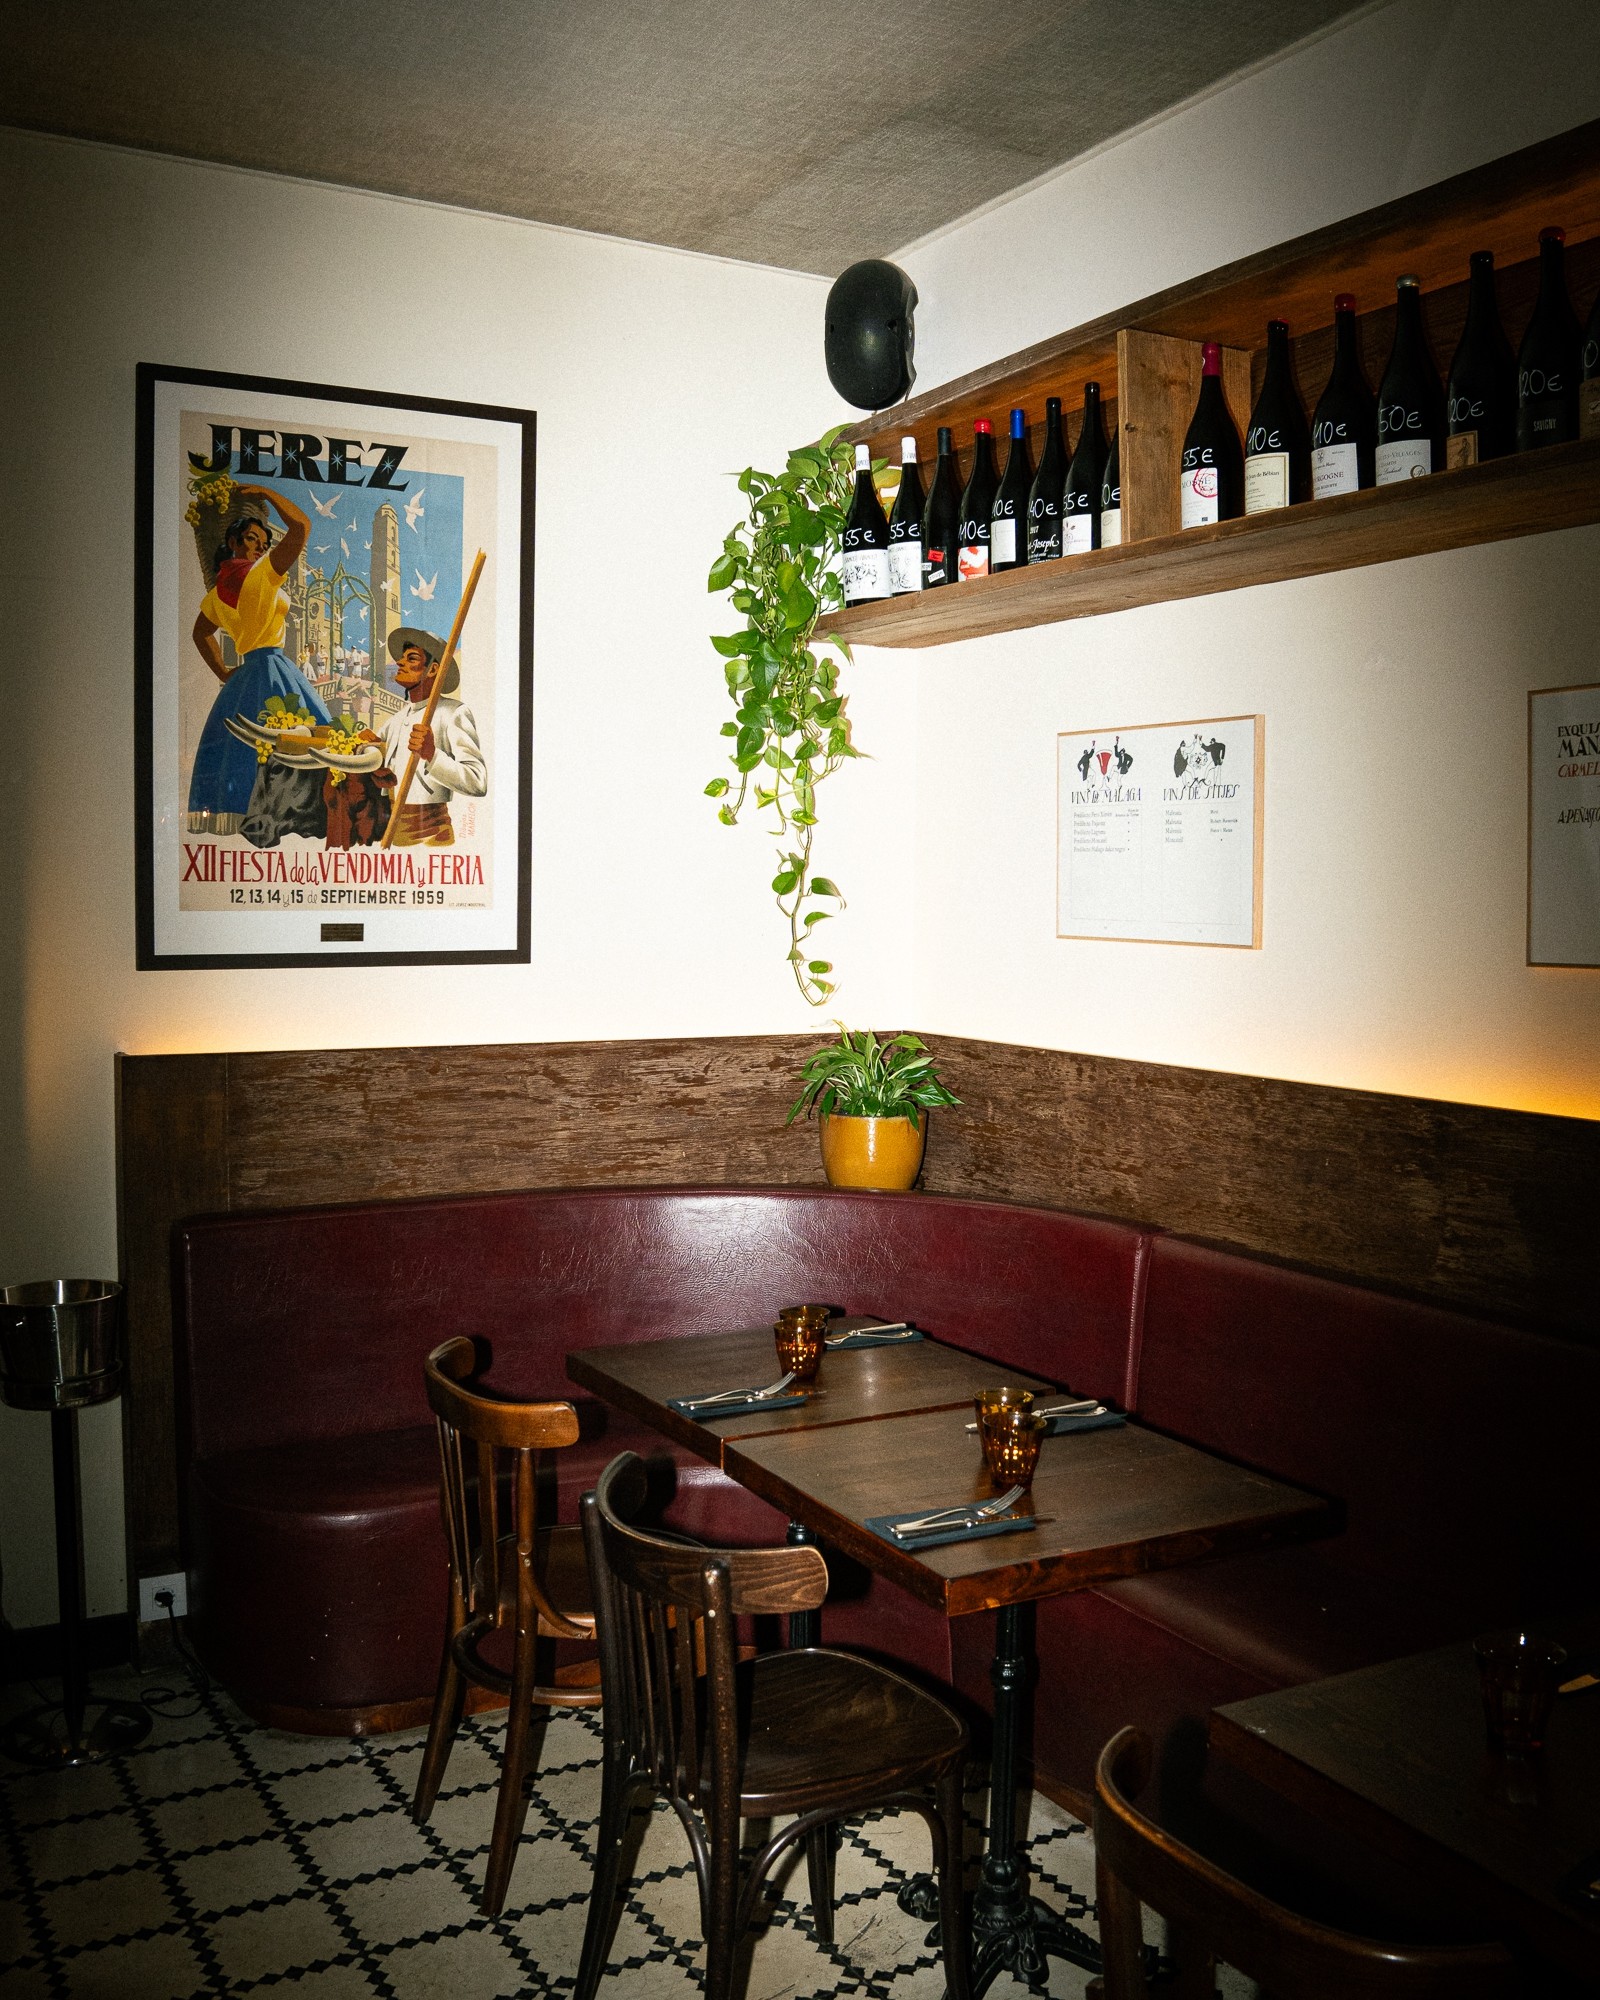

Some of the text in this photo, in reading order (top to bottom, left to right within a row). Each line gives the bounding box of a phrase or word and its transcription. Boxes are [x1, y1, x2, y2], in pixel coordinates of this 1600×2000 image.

[1533, 418, 1557, 431] SAVIGNY
[188, 423, 410, 492] JEREZ
[845, 527, 876, 546] 55€
[890, 520, 922, 540] 55€
[182, 844, 218, 882] XII
[219, 850, 288, 883] FIESTA
[290, 851, 305, 885] de
[318, 853, 414, 884] VENDIMIA
[417, 867, 426, 888] y
[428, 854, 484, 885] FERIA
[283, 894, 290, 907] y
[291, 889, 304, 904] 15
[307, 891, 318, 904] de
[321, 889, 406, 905] SEPTIEMBRE
[412, 891, 444, 905] 1959
